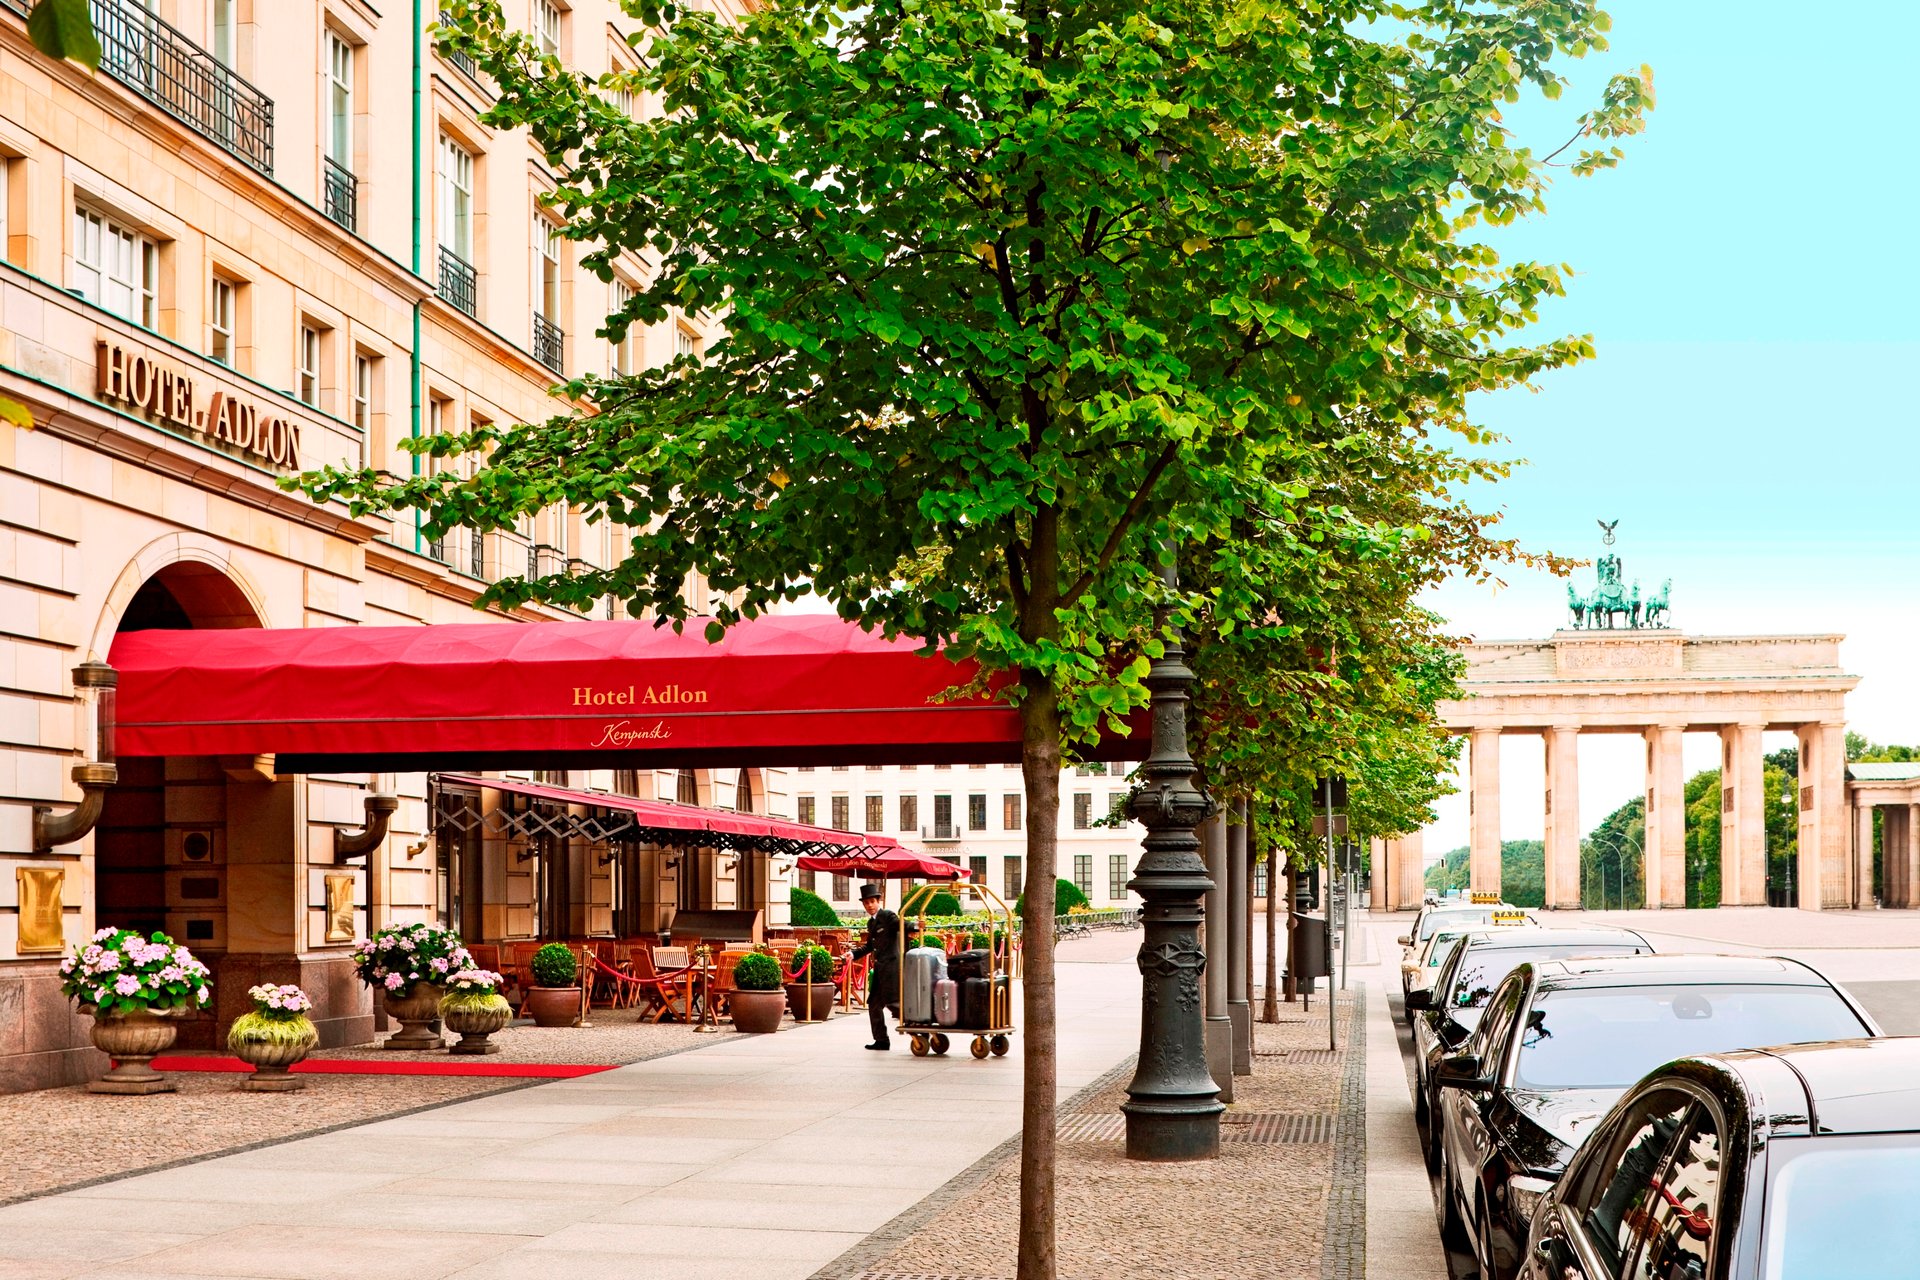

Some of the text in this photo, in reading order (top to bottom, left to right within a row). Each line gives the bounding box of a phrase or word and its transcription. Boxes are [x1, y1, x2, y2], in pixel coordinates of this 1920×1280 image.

[101, 340, 301, 470] HOTEL ADLON
[572, 684, 709, 706] Hotel Adlon
[590, 720, 673, 748] Kempinski
[845, 859, 859, 867] Adlon
